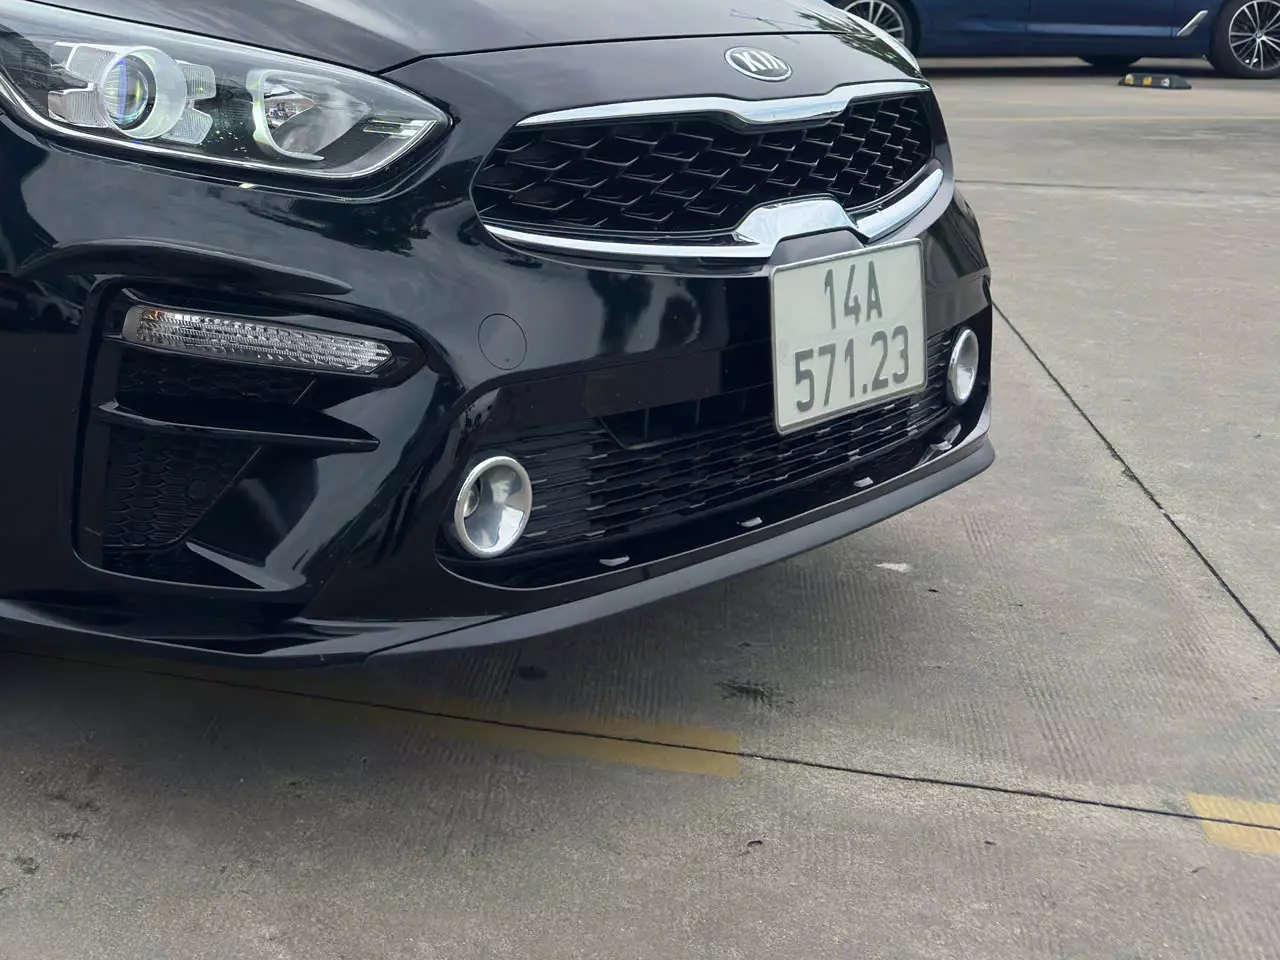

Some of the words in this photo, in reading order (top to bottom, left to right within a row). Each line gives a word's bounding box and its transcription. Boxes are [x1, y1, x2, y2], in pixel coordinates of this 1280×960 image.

[732, 50, 787, 72] KIA
[824, 260, 882, 329] 14A
[794, 325, 909, 412] 571.23
